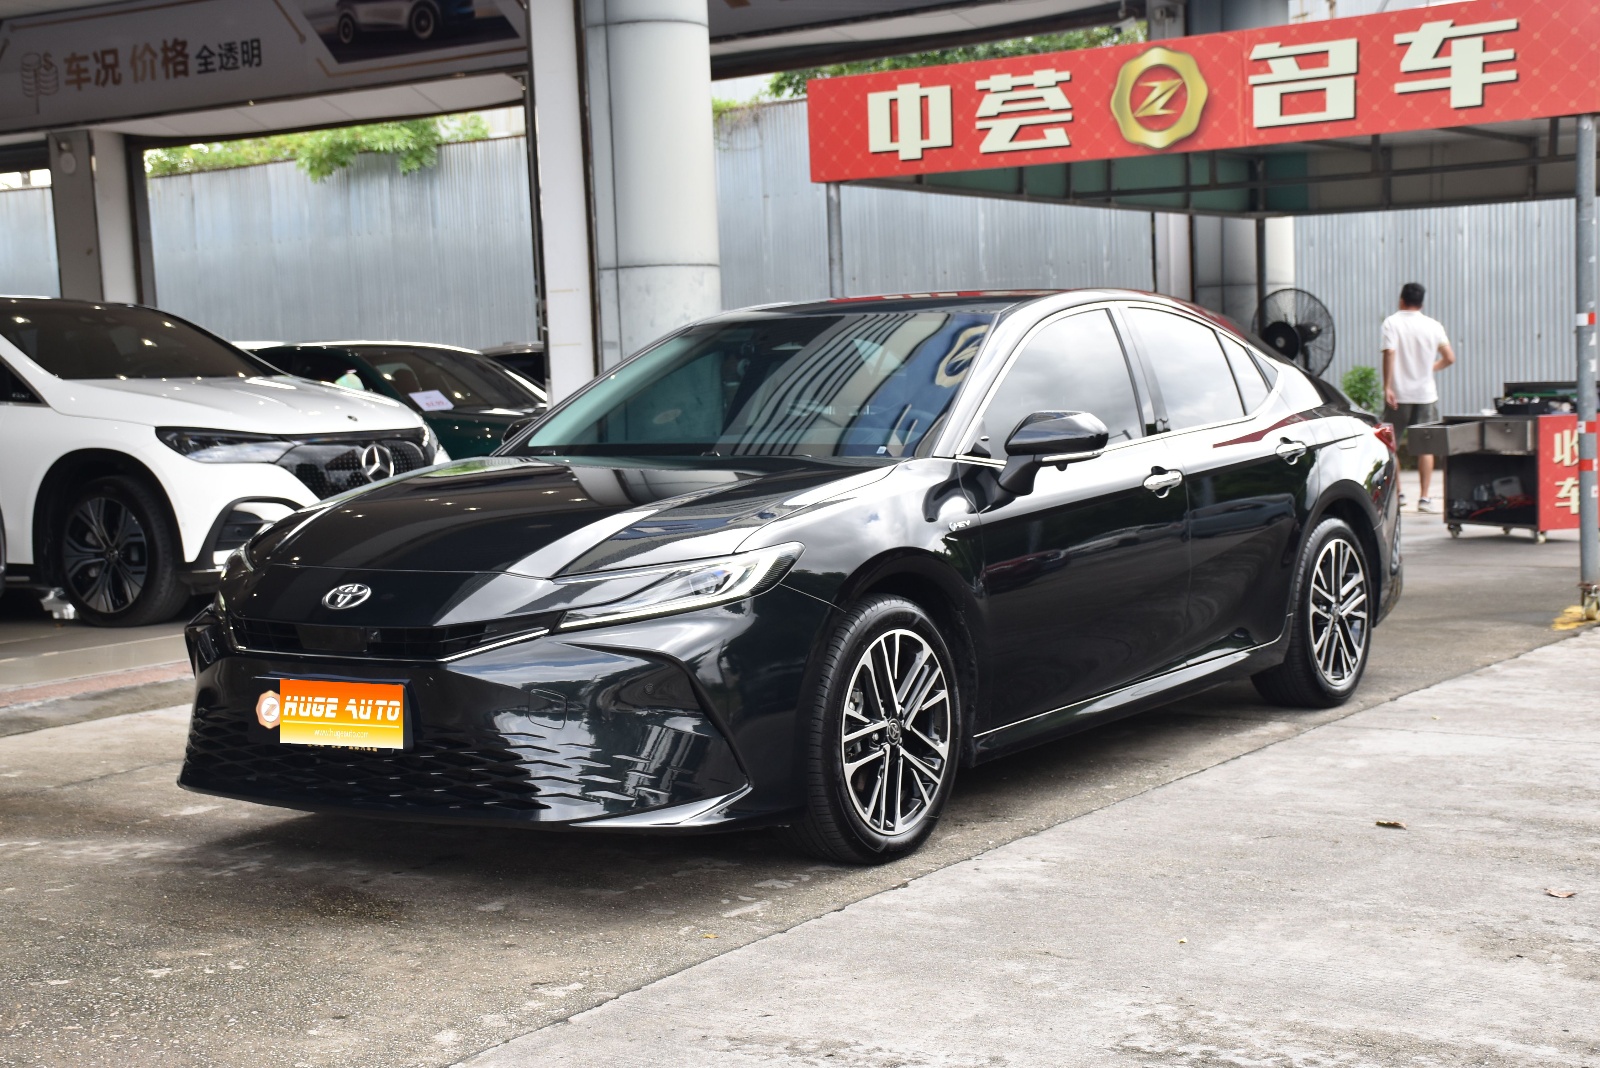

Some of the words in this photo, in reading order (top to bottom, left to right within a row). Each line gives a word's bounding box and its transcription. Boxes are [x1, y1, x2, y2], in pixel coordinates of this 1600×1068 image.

[64, 49, 122, 91] 车况
[130, 38, 190, 83] 价格
[195, 38, 262, 75] 全透明
[867, 70, 1073, 161] 中荟
[1248, 19, 1520, 129] 名车
